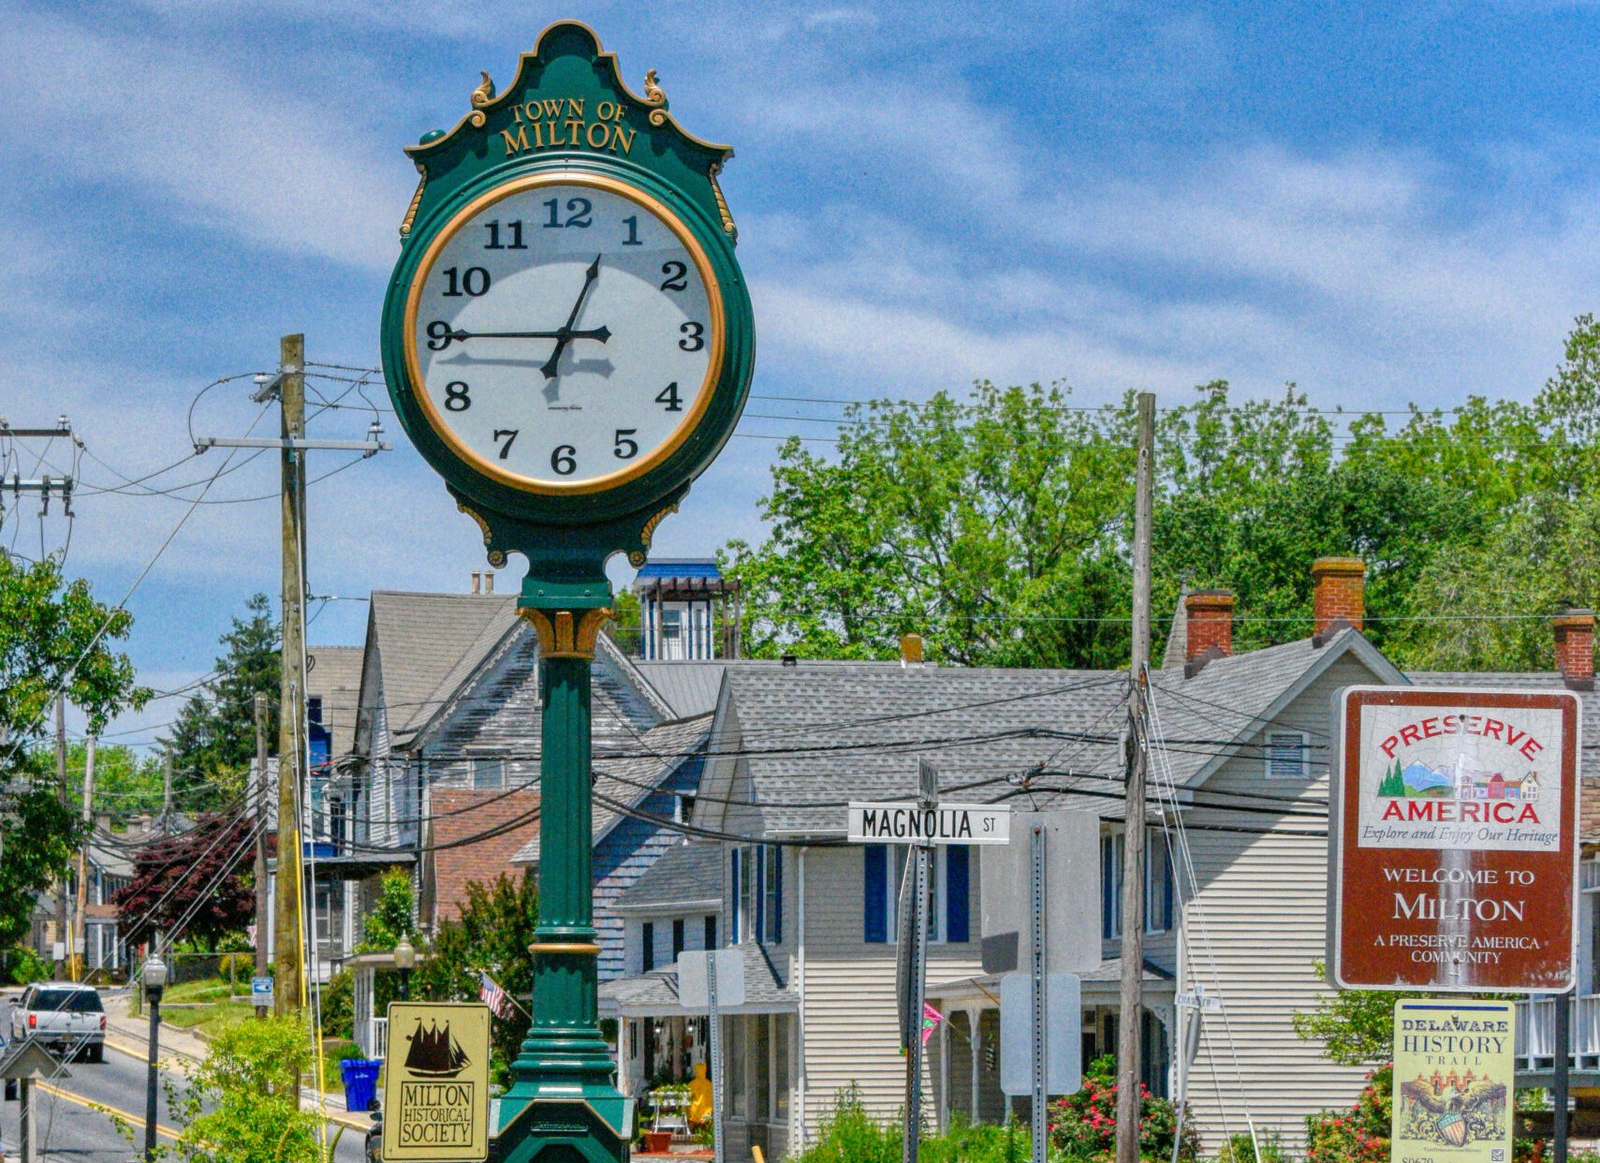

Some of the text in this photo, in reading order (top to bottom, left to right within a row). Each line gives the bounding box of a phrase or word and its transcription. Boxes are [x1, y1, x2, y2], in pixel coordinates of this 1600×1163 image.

[508, 98, 628, 123] TOWN OF
[500, 119, 637, 155] MILTON
[542, 197, 593, 229] 12
[483, 219, 529, 250] 11
[621, 215, 644, 246] 1
[441, 265, 492, 297] 10
[660, 260, 689, 292] 2
[426, 320, 453, 351] 9
[678, 321, 705, 352] 3
[444, 380, 472, 412] 8
[654, 381, 684, 412] 4
[493, 429, 520, 460] 7
[613, 428, 639, 460] 5
[550, 444, 578, 476] 6
[1379, 714, 1545, 762] PRESERVE
[862, 808, 996, 839] MAGNOLIA ST
[1381, 800, 1542, 824] AMERICA
[1362, 825, 1558, 846] Explore and Enjoy Our Heritage
[1383, 868, 1536, 885] WELCOME TO
[1373, 934, 1540, 950] A PRESERVE AMERICA
[1411, 950, 1503, 965] COMMUNITY
[1401, 1018, 1510, 1033] DELAWARE
[1402, 1034, 1508, 1054] HISTORY
[1426, 1055, 1482, 1066] TRAIL
[403, 1084, 471, 1107] MILTON
[403, 1108, 471, 1122] HISTORICAL
[402, 1122, 471, 1143] SOCIETY
